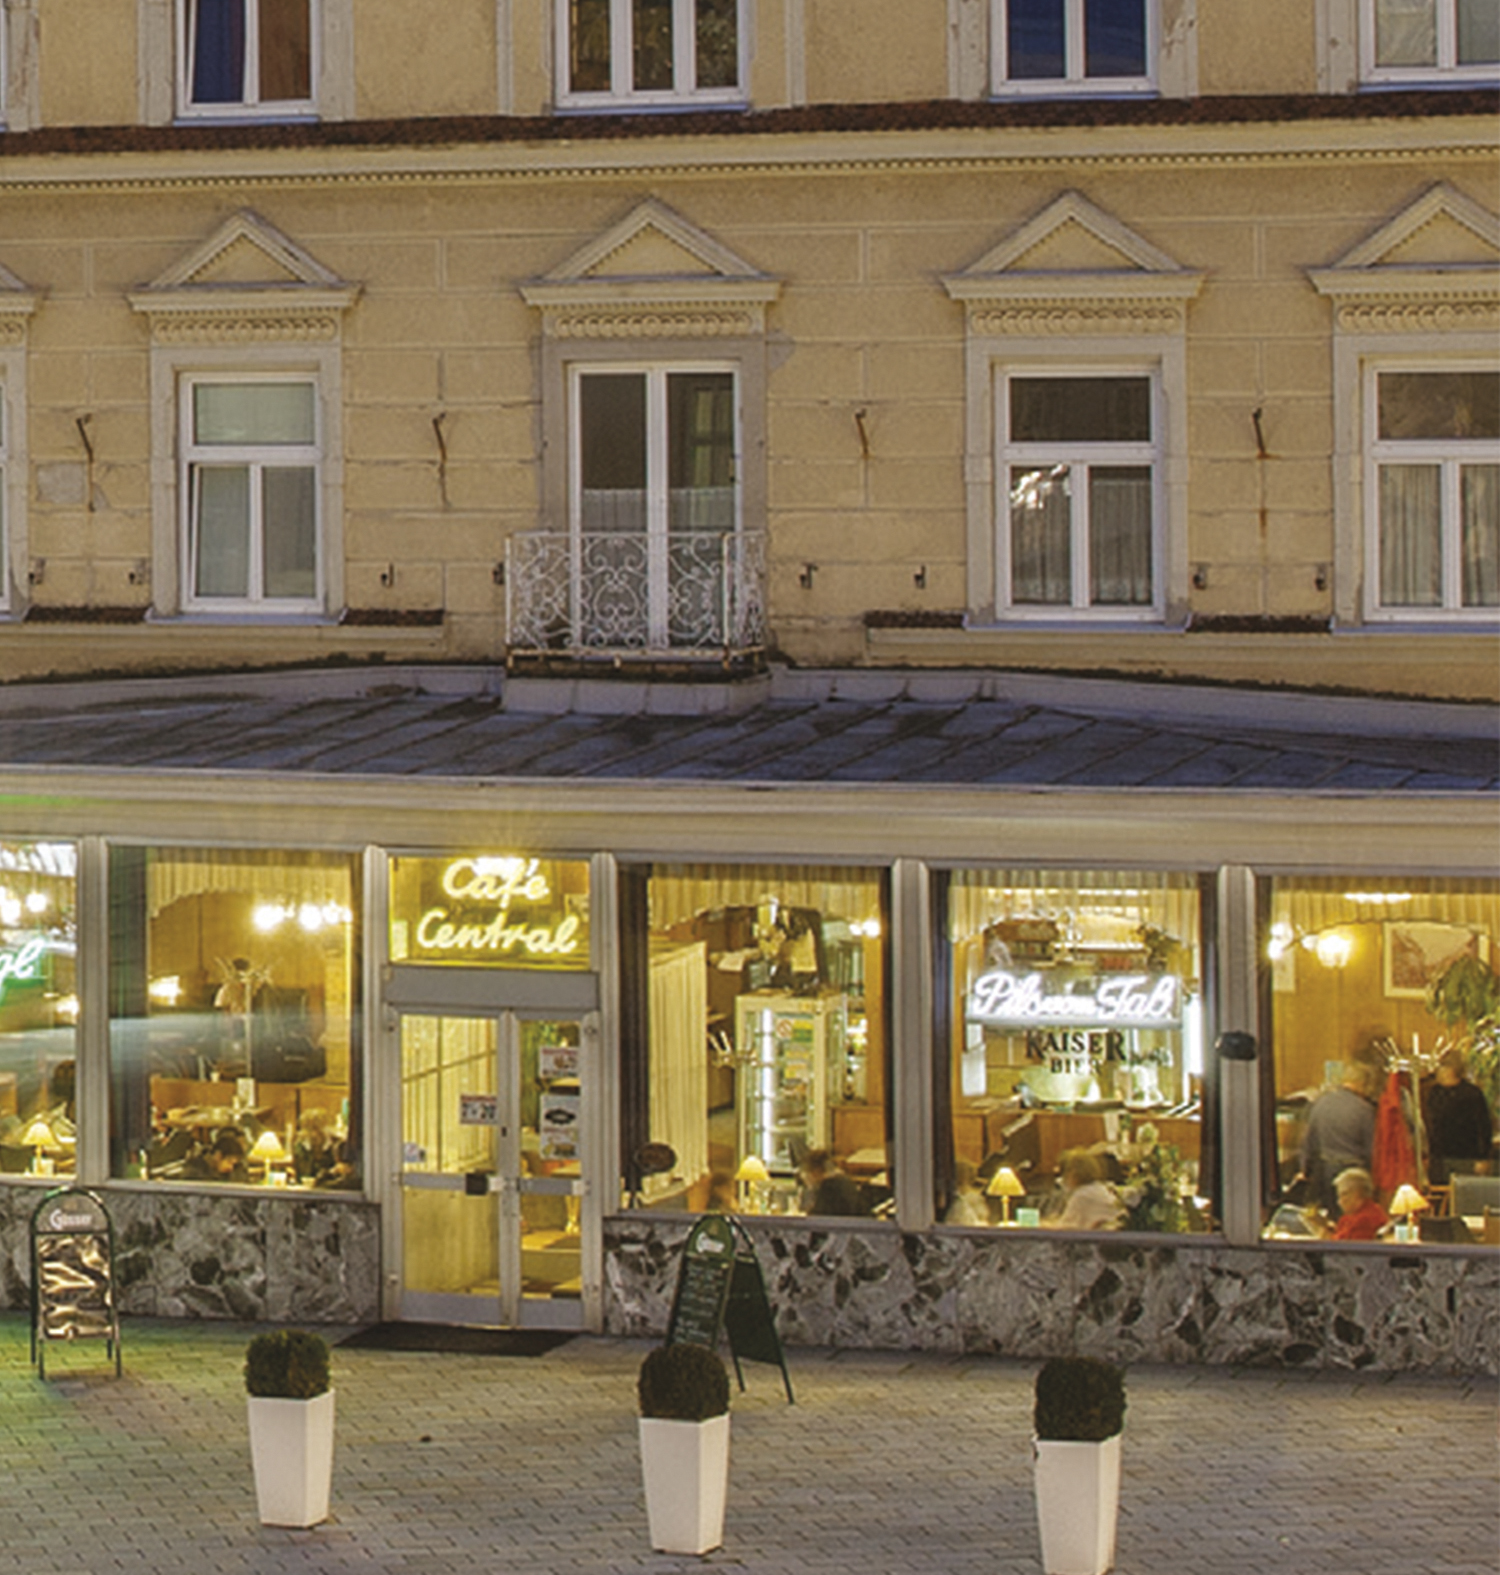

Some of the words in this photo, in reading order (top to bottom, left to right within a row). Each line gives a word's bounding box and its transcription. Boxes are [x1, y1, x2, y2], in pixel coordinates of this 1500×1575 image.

[442, 857, 550, 909] Café
[416, 909, 580, 954] Central
[1024, 1027, 1127, 1062] KAISER
